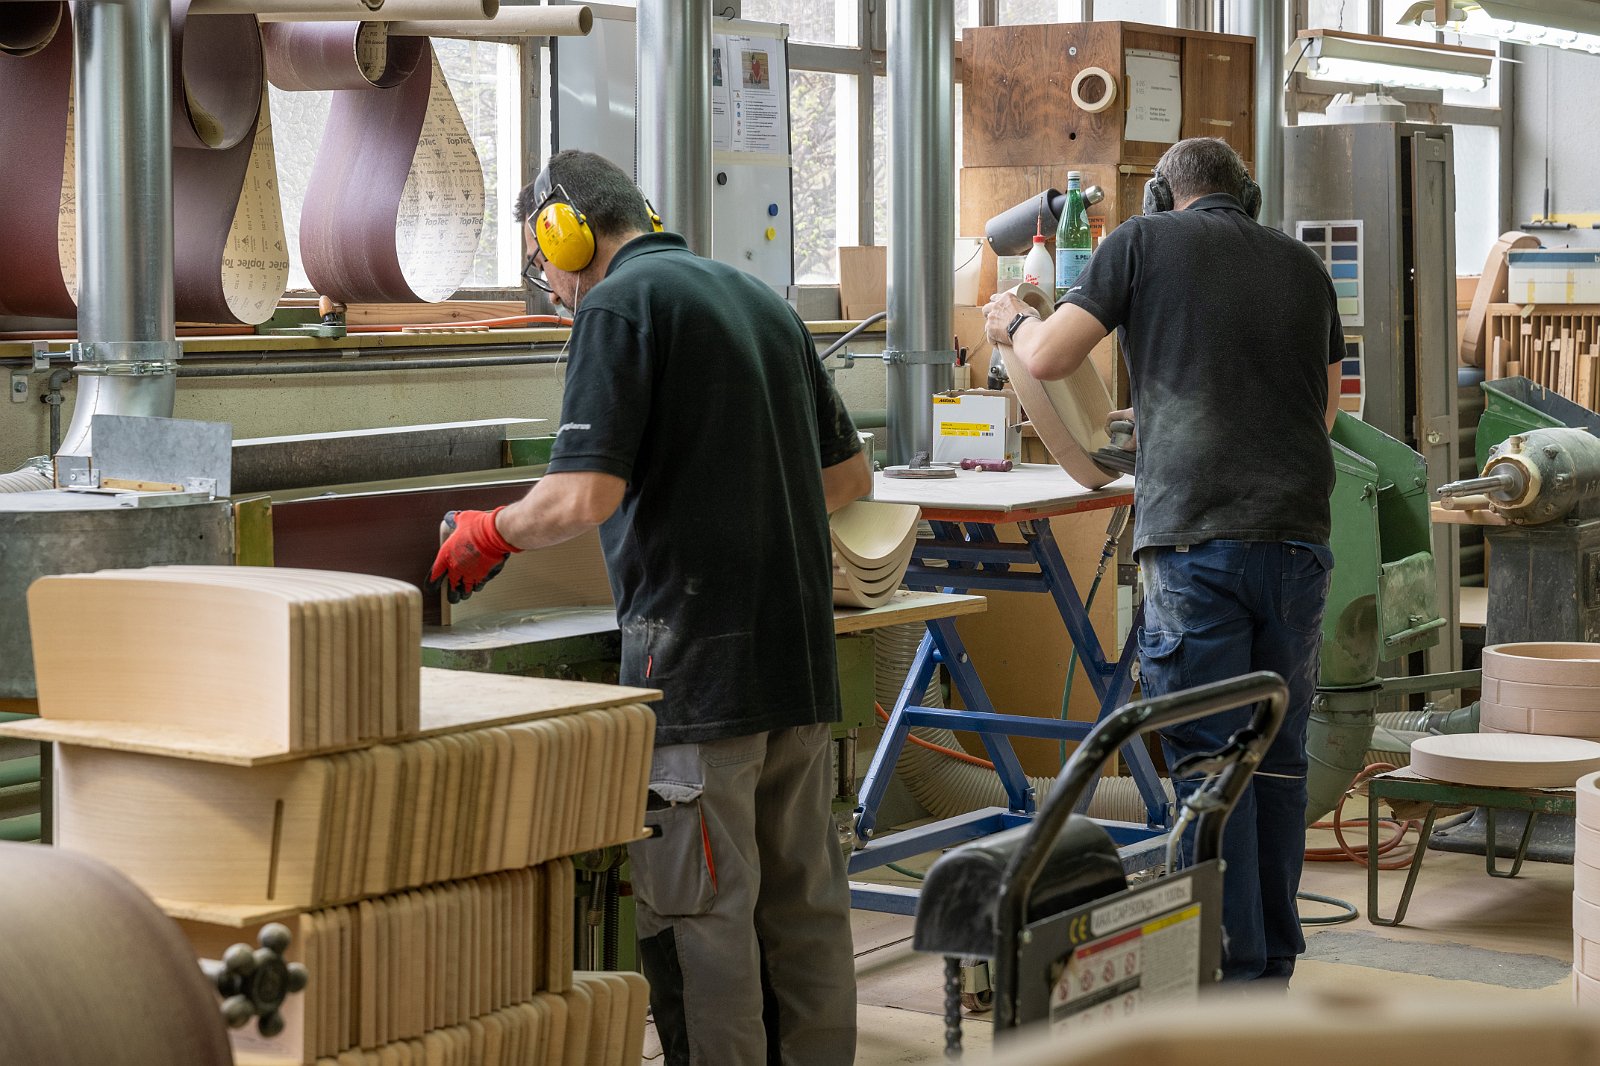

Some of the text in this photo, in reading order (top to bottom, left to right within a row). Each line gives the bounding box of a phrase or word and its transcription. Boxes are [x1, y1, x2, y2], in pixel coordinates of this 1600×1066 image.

[446, 136, 472, 146] TopTec
[425, 217, 449, 227] TopTec
[460, 216, 484, 227] TopTec
[237, 257, 266, 270] TopTec
